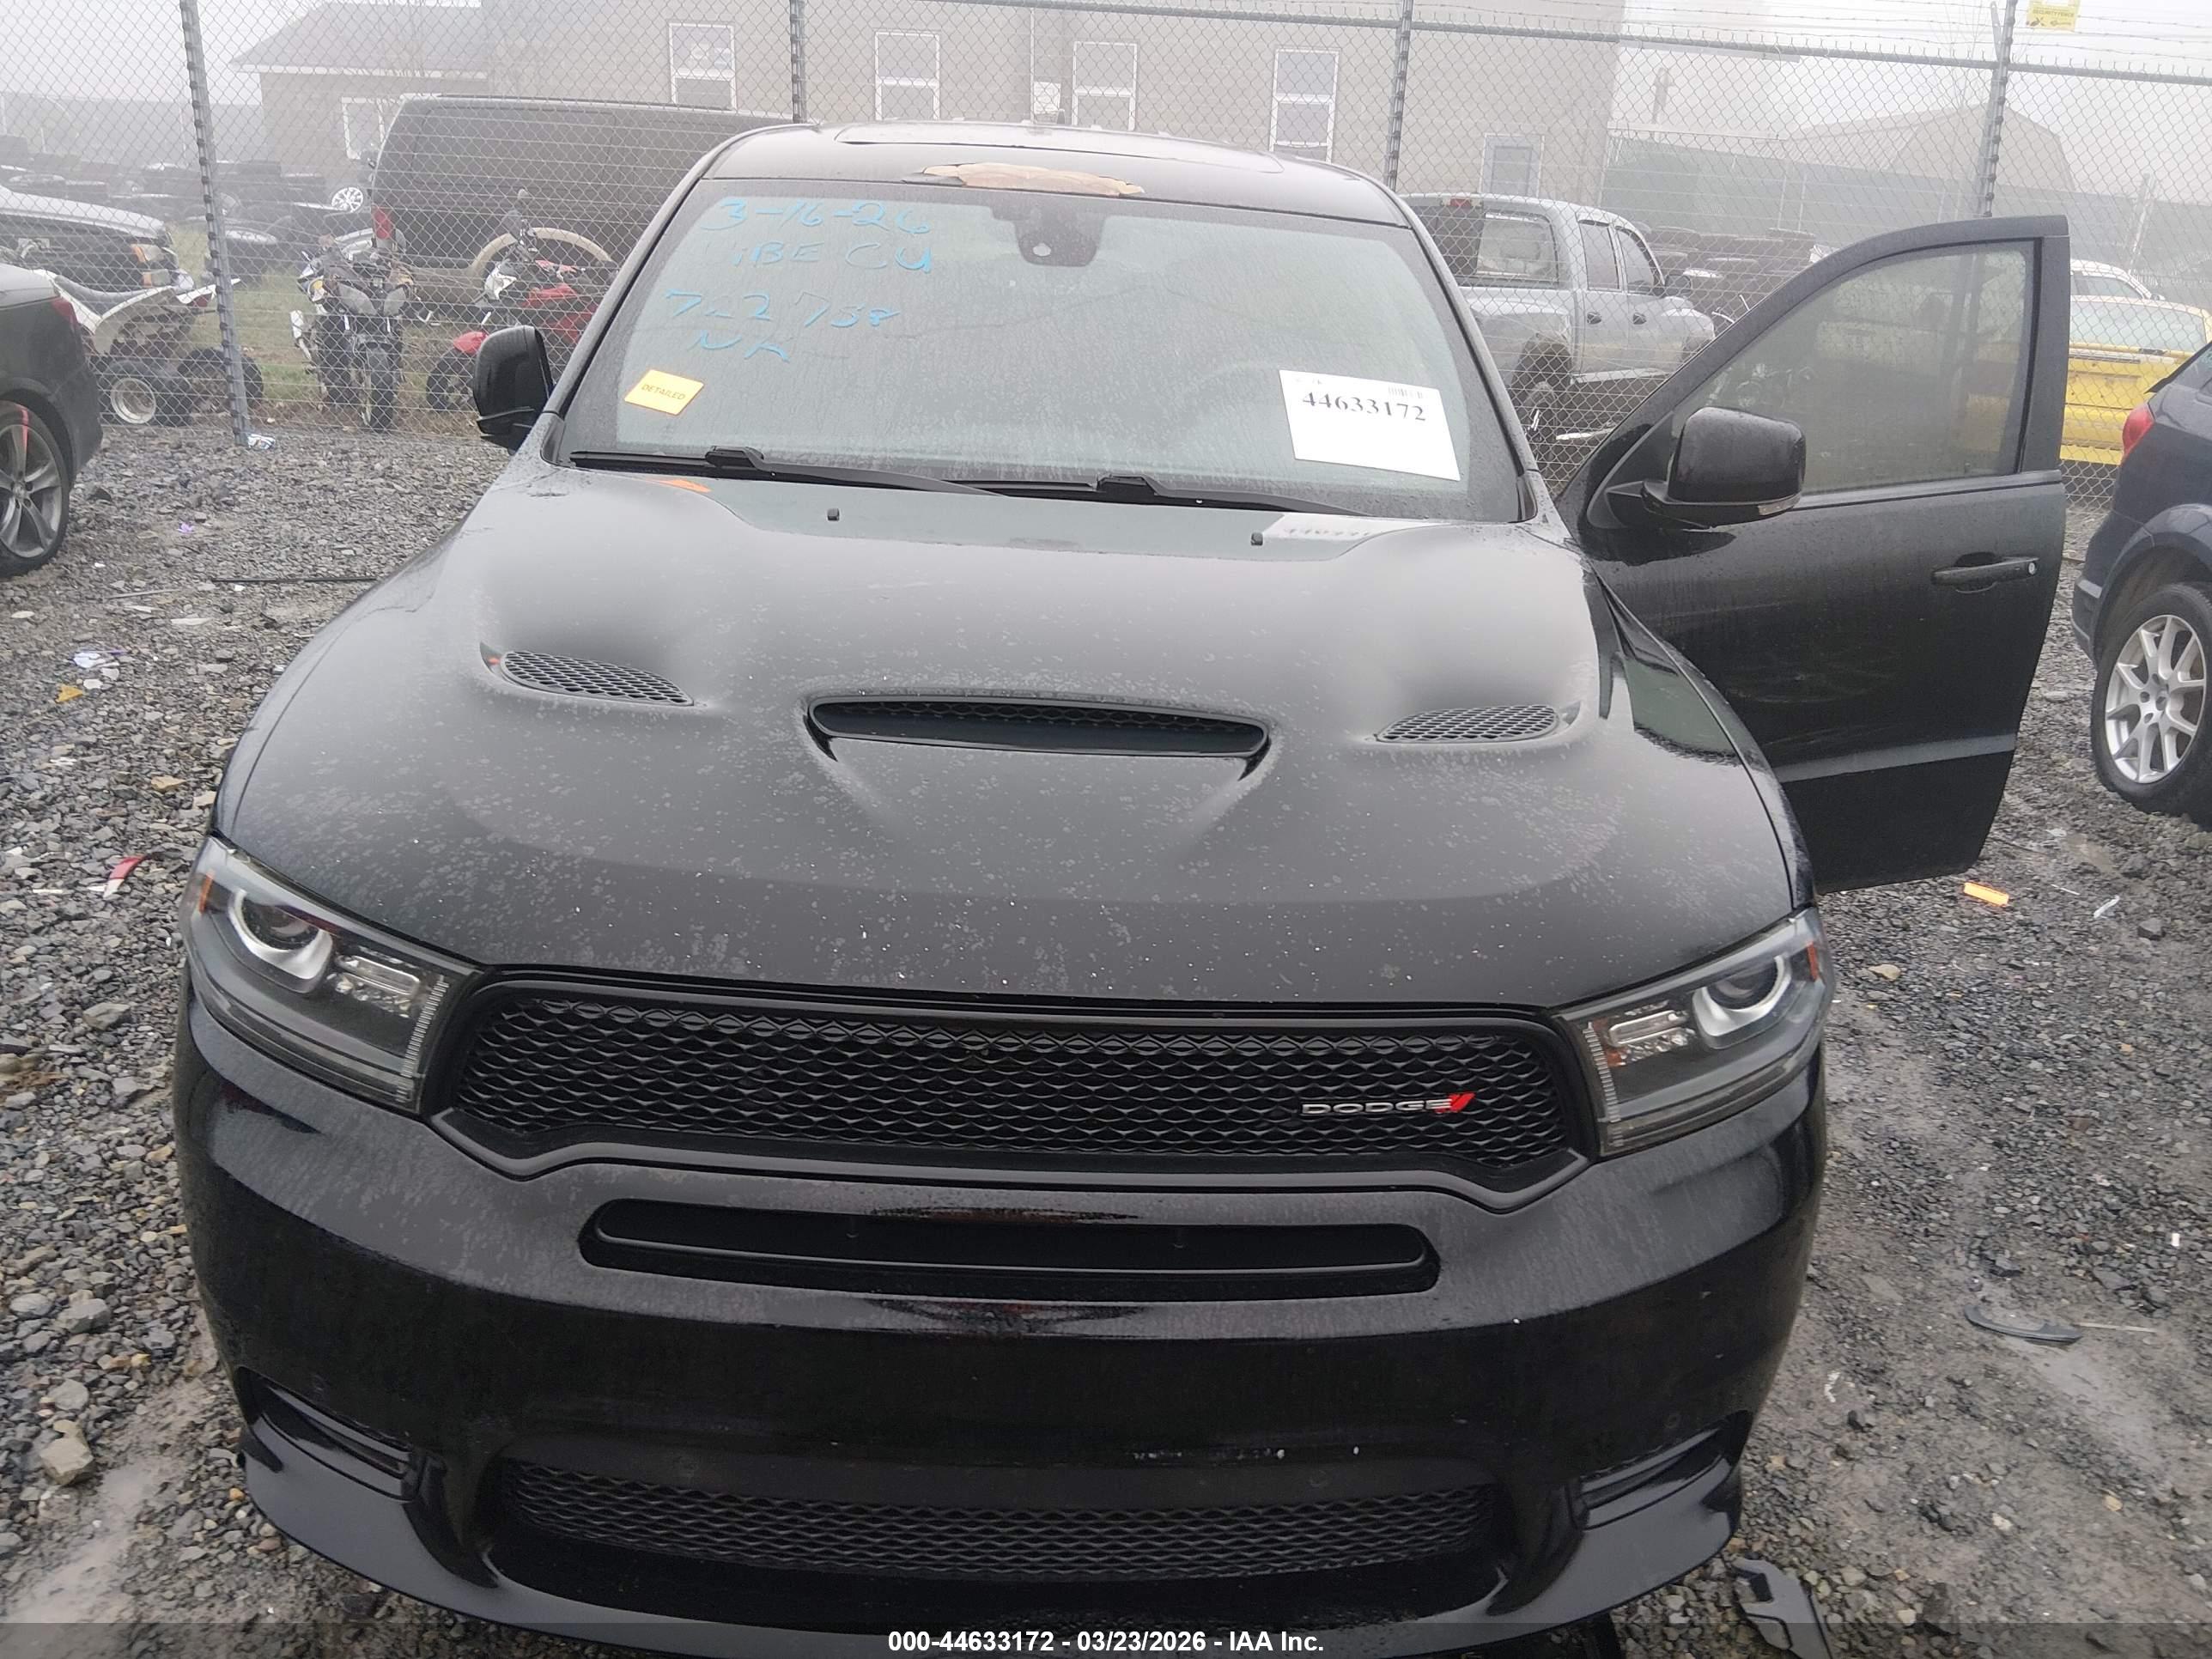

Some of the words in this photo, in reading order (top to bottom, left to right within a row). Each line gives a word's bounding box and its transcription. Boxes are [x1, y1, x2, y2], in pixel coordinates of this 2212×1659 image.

[700, 197, 933, 234] 3-16-26
[641, 383, 687, 401] DETAILED
[1301, 392, 1426, 422] 44633172
[1301, 1098, 1454, 1115] DODGE
